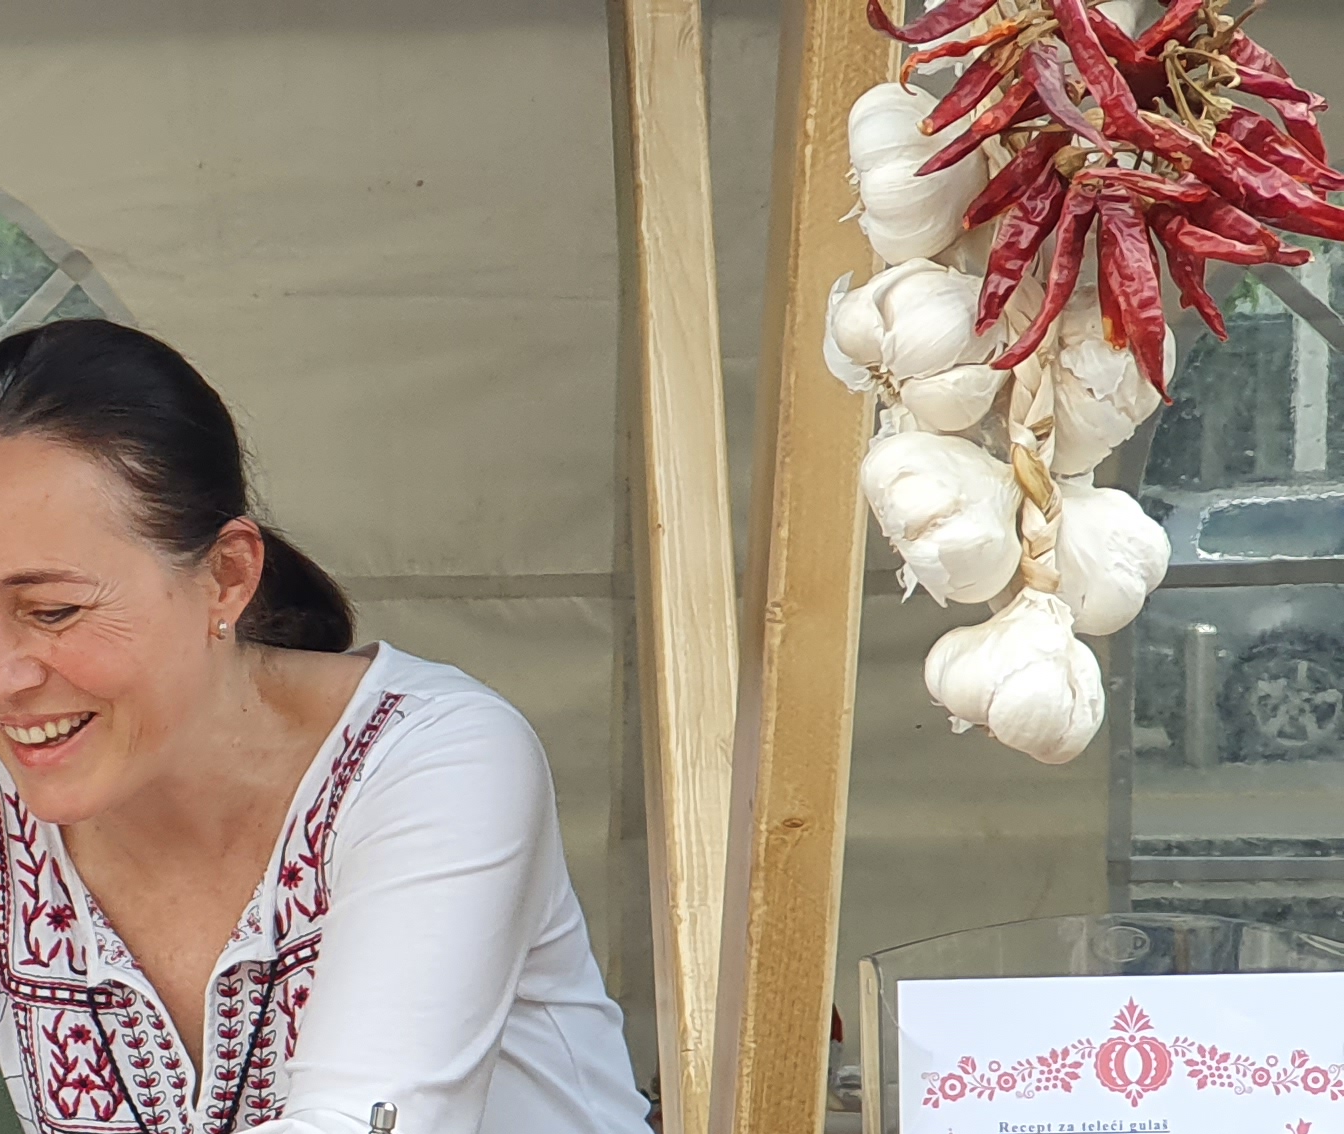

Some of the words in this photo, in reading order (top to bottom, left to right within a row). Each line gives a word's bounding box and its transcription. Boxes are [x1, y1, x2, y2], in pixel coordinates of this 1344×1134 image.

[998, 1121, 1052, 1134] Recept
[1058, 1122, 1074, 1132] za
[1081, 1119, 1123, 1132] teleći
[1129, 1118, 1169, 1133] gulaš
